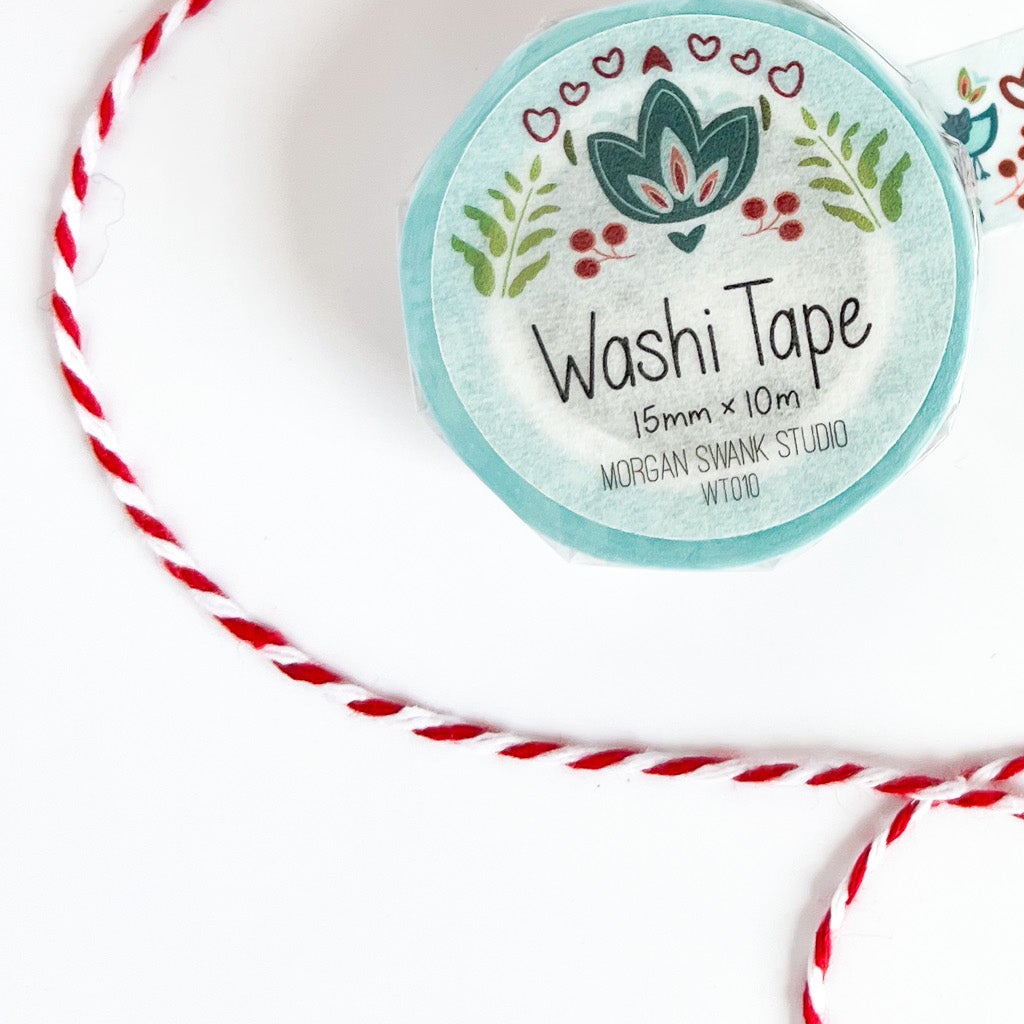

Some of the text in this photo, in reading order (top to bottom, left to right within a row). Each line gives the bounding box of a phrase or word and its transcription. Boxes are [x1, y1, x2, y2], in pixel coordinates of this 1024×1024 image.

[532, 277, 872, 403] Washi Tape
[633, 404, 712, 438] 15mm
[746, 386, 801, 418] 10m
[600, 419, 848, 491] MORGAN SWANK STUDIO
[701, 473, 760, 506] WT010
